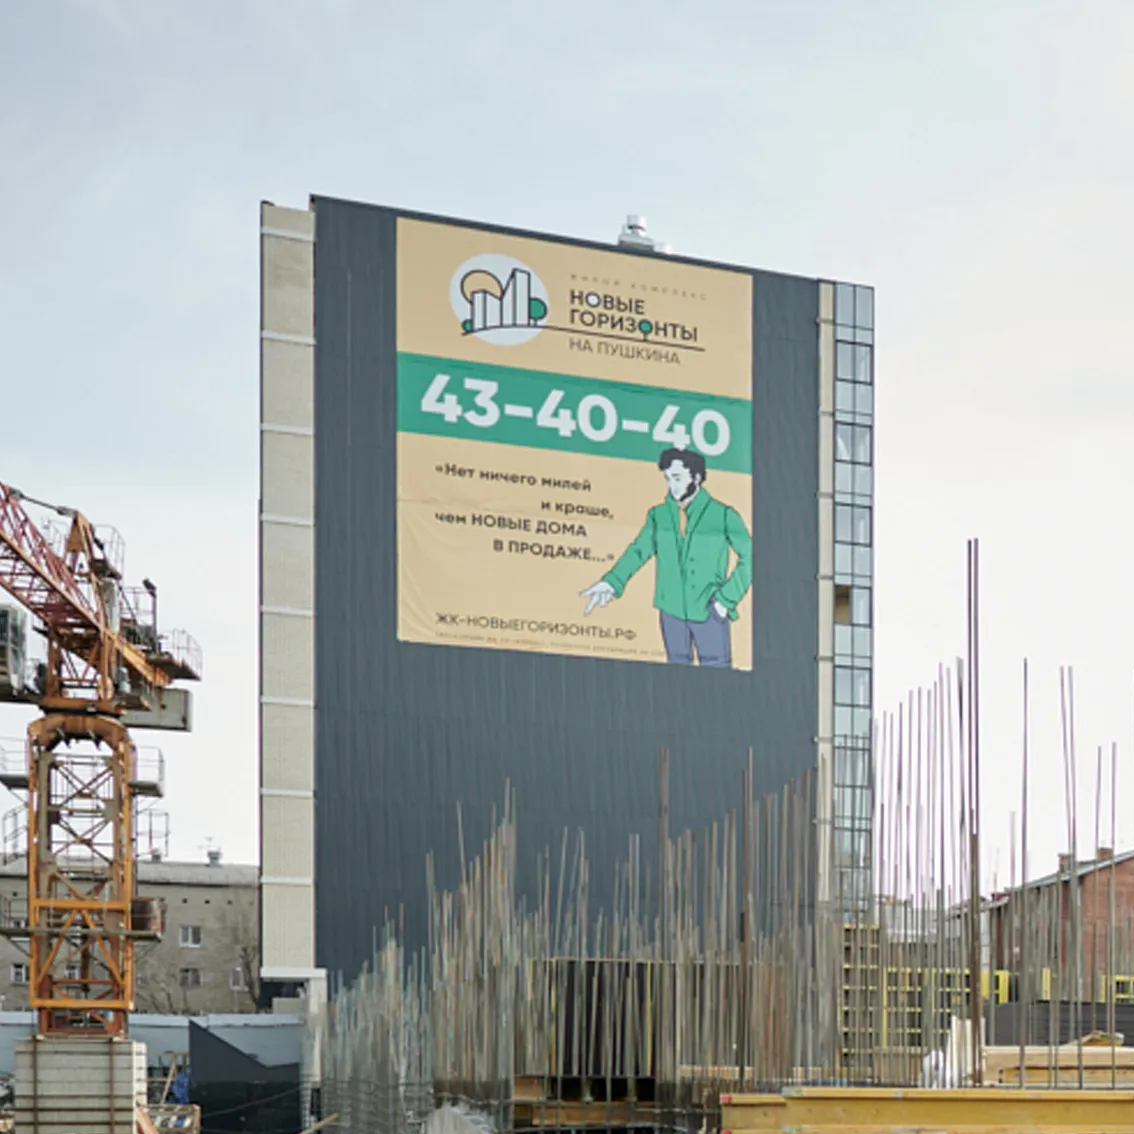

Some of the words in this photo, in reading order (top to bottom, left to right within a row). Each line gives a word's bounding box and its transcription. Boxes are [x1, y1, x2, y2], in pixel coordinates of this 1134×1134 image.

[569, 288, 646, 315] НОВЫЕ
[569, 308, 698, 343] ГОРИЗОНТЫ
[569, 337, 593, 354] НА
[597, 341, 681, 365] ПУШКИНА
[435, 463, 475, 478] «Нет
[479, 470, 538, 487] ничего
[541, 476, 592, 492] милей
[541, 501, 551, 510] и
[555, 503, 615, 520] краше,
[435, 512, 467, 525] чем
[471, 513, 533, 533] НОВЫЕ
[535, 520, 588, 538] ДОМА
[493, 538, 504, 552] В
[435, 612, 637, 641] ЖК-НОВЫЕГОРИЗОНТЫ.РФ
